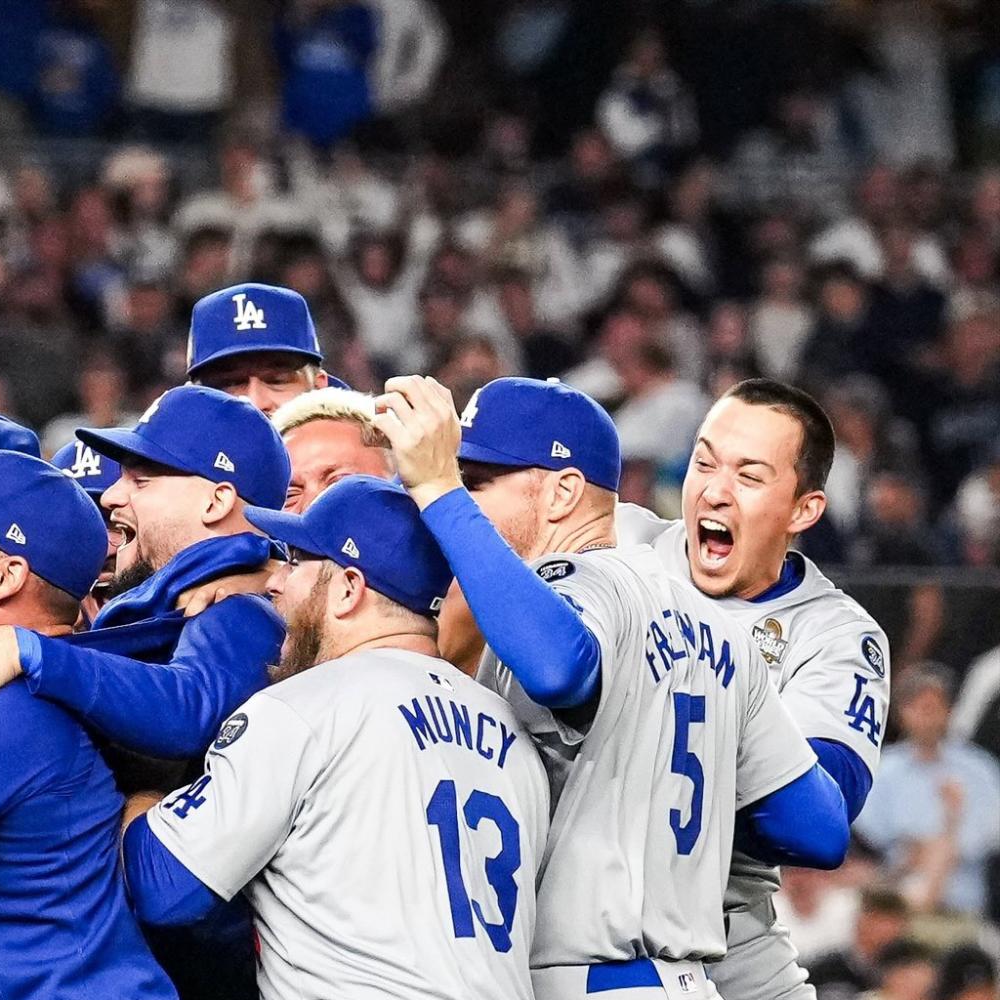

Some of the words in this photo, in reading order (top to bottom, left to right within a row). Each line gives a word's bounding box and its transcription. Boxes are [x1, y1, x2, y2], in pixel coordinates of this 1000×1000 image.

[232, 293, 267, 331] LA
[397, 695, 517, 769] MUNCY
[844, 673, 881, 747] LA
[669, 692, 705, 856] 5
[426, 779, 521, 953] 13
